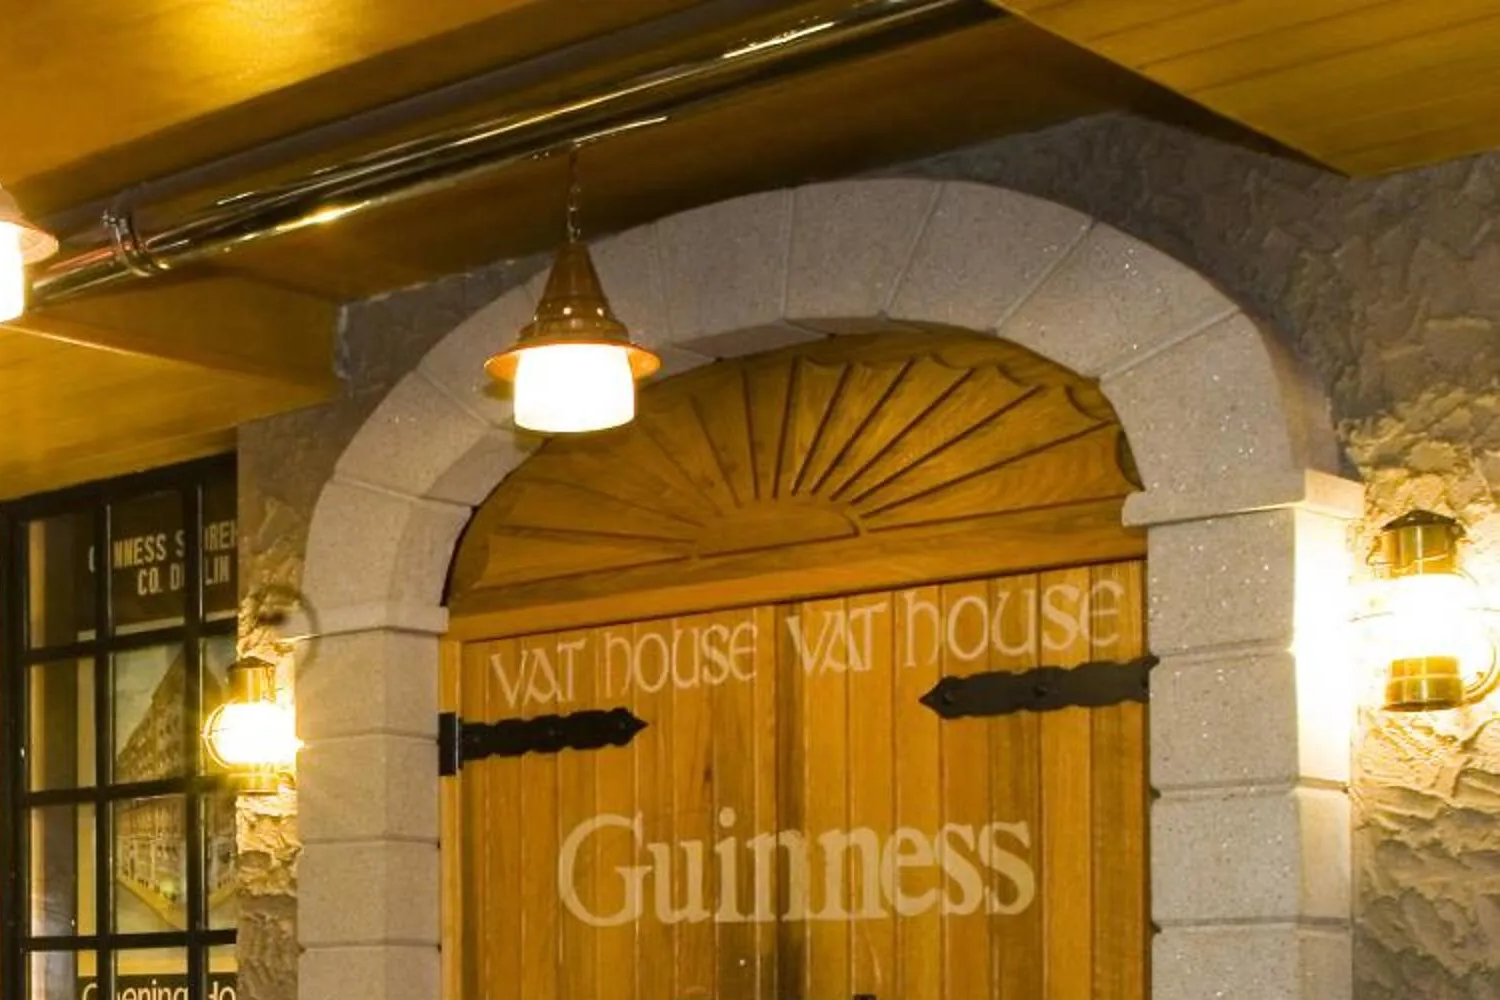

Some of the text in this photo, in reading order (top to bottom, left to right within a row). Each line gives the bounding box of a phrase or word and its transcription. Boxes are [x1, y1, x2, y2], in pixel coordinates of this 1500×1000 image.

[88, 532, 167, 573] NNESS
[170, 554, 231, 592] DLIN
[491, 638, 585, 708] VAT
[786, 601, 888, 677] VAT
[557, 806, 1035, 928] Guinness
